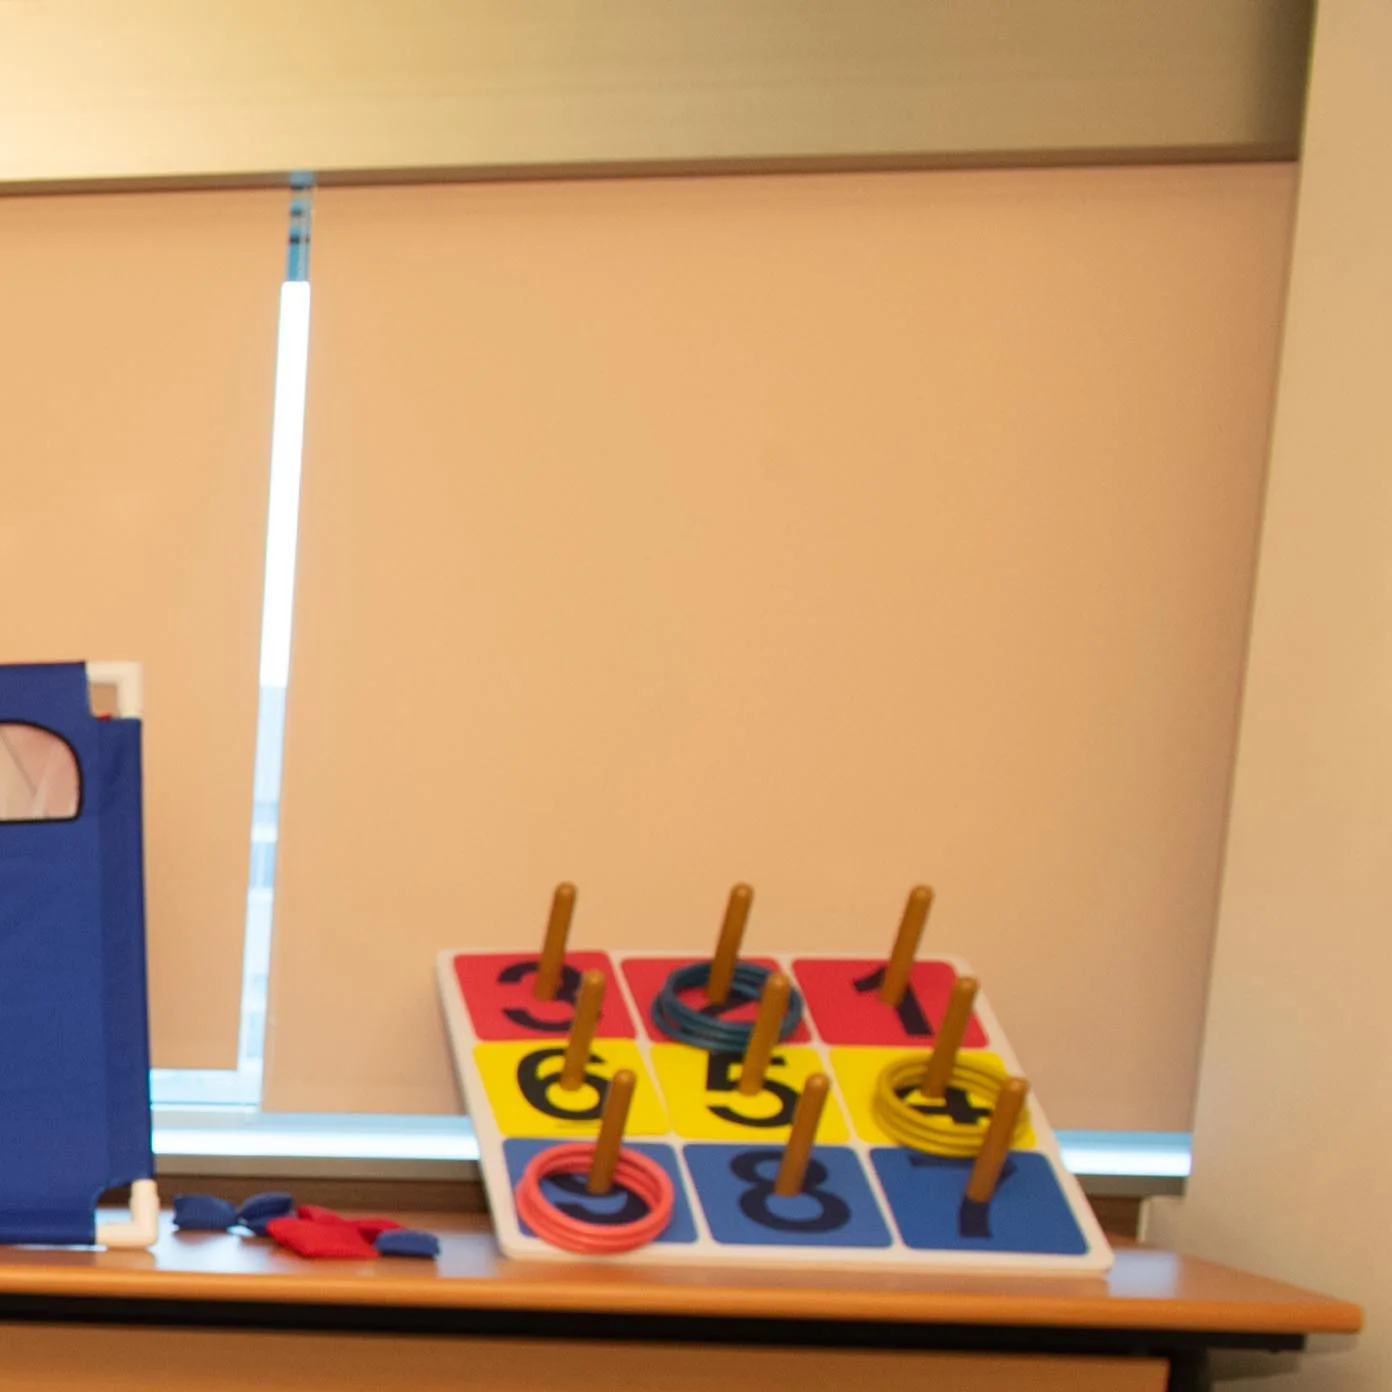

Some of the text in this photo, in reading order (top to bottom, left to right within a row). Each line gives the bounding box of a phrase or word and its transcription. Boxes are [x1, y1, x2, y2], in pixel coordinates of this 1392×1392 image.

[516, 1048, 612, 1120] 6
[706, 1048, 799, 1127] 5
[729, 1150, 851, 1233] 8
[908, 1152, 1016, 1239] 7
